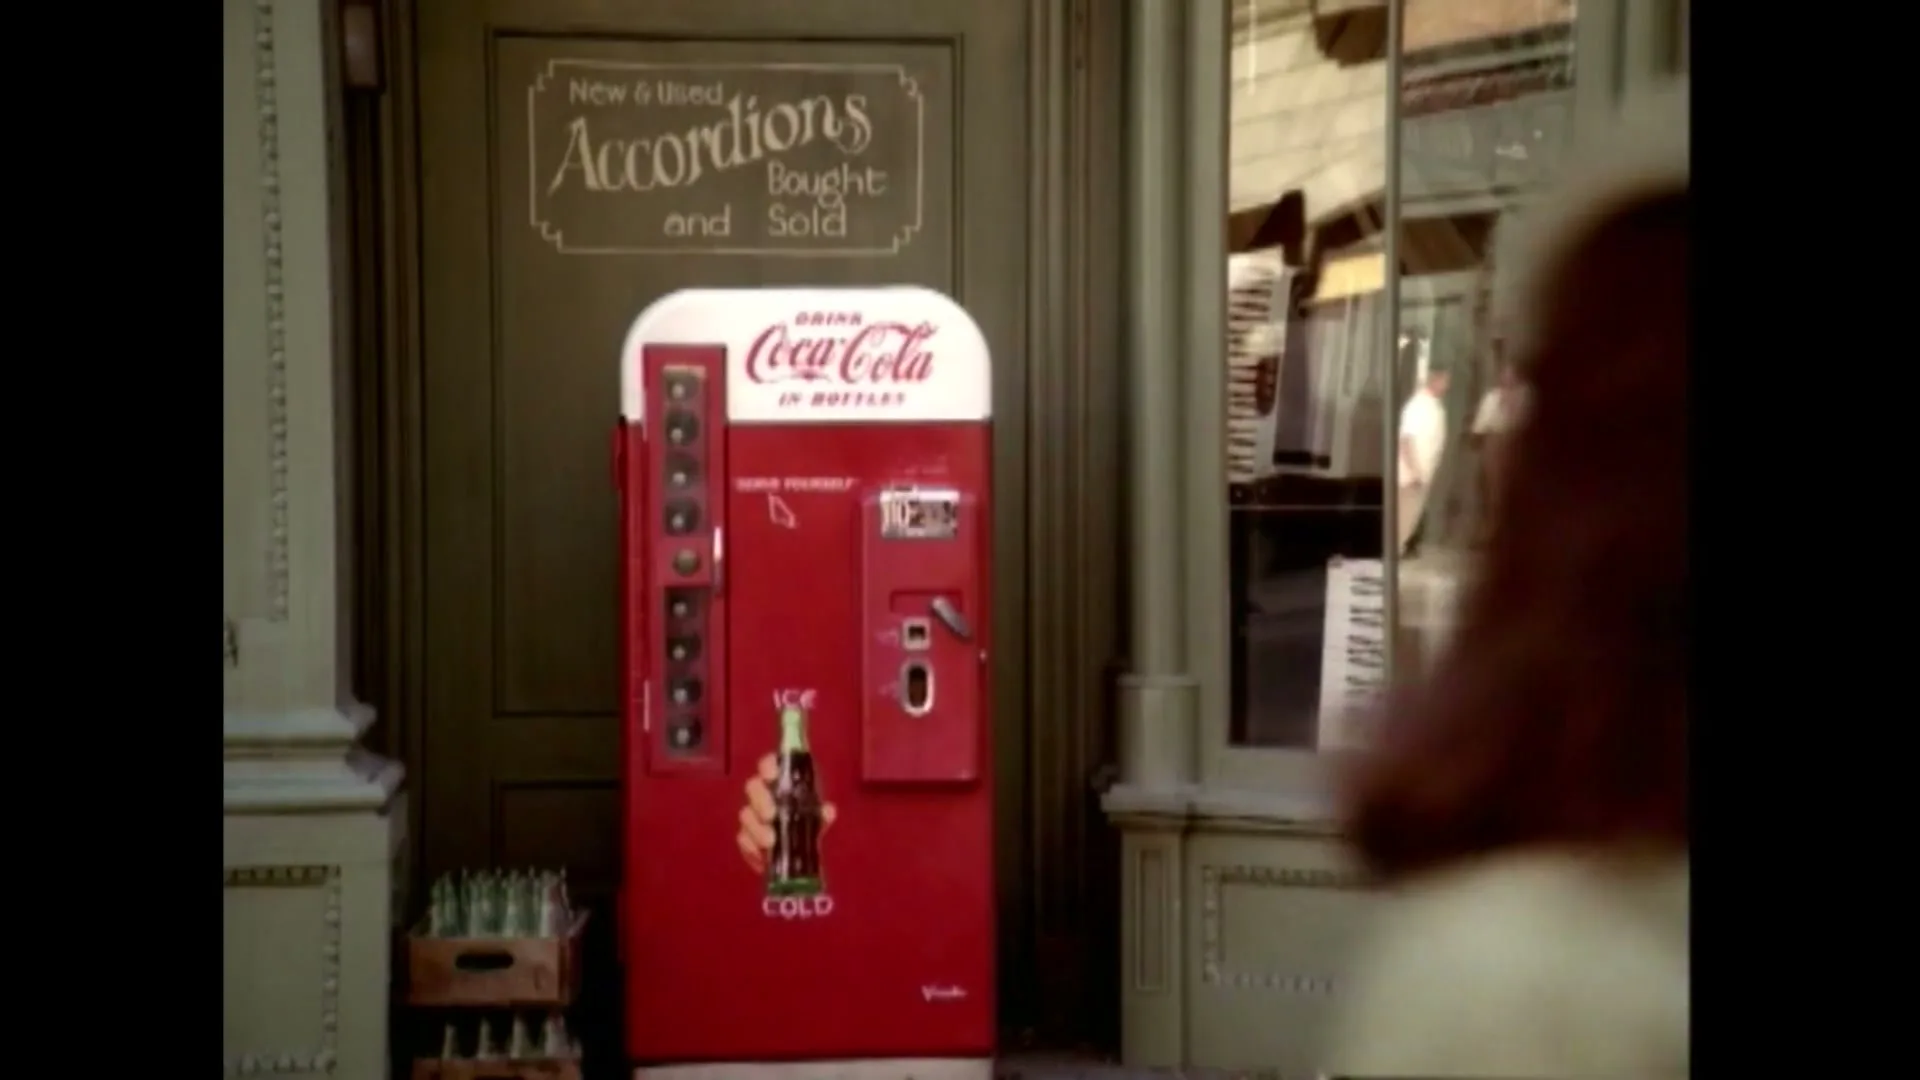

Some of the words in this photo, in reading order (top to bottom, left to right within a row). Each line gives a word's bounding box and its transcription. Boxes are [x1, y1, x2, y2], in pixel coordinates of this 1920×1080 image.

[569, 78, 625, 104] New
[634, 80, 651, 105] &
[658, 81, 724, 105] Used
[548, 94, 872, 196] Accordions
[768, 161, 887, 208] Bought
[663, 204, 731, 237] and
[768, 203, 847, 237] Sold
[773, 689, 817, 709] ICE
[763, 897, 834, 919] COLD
